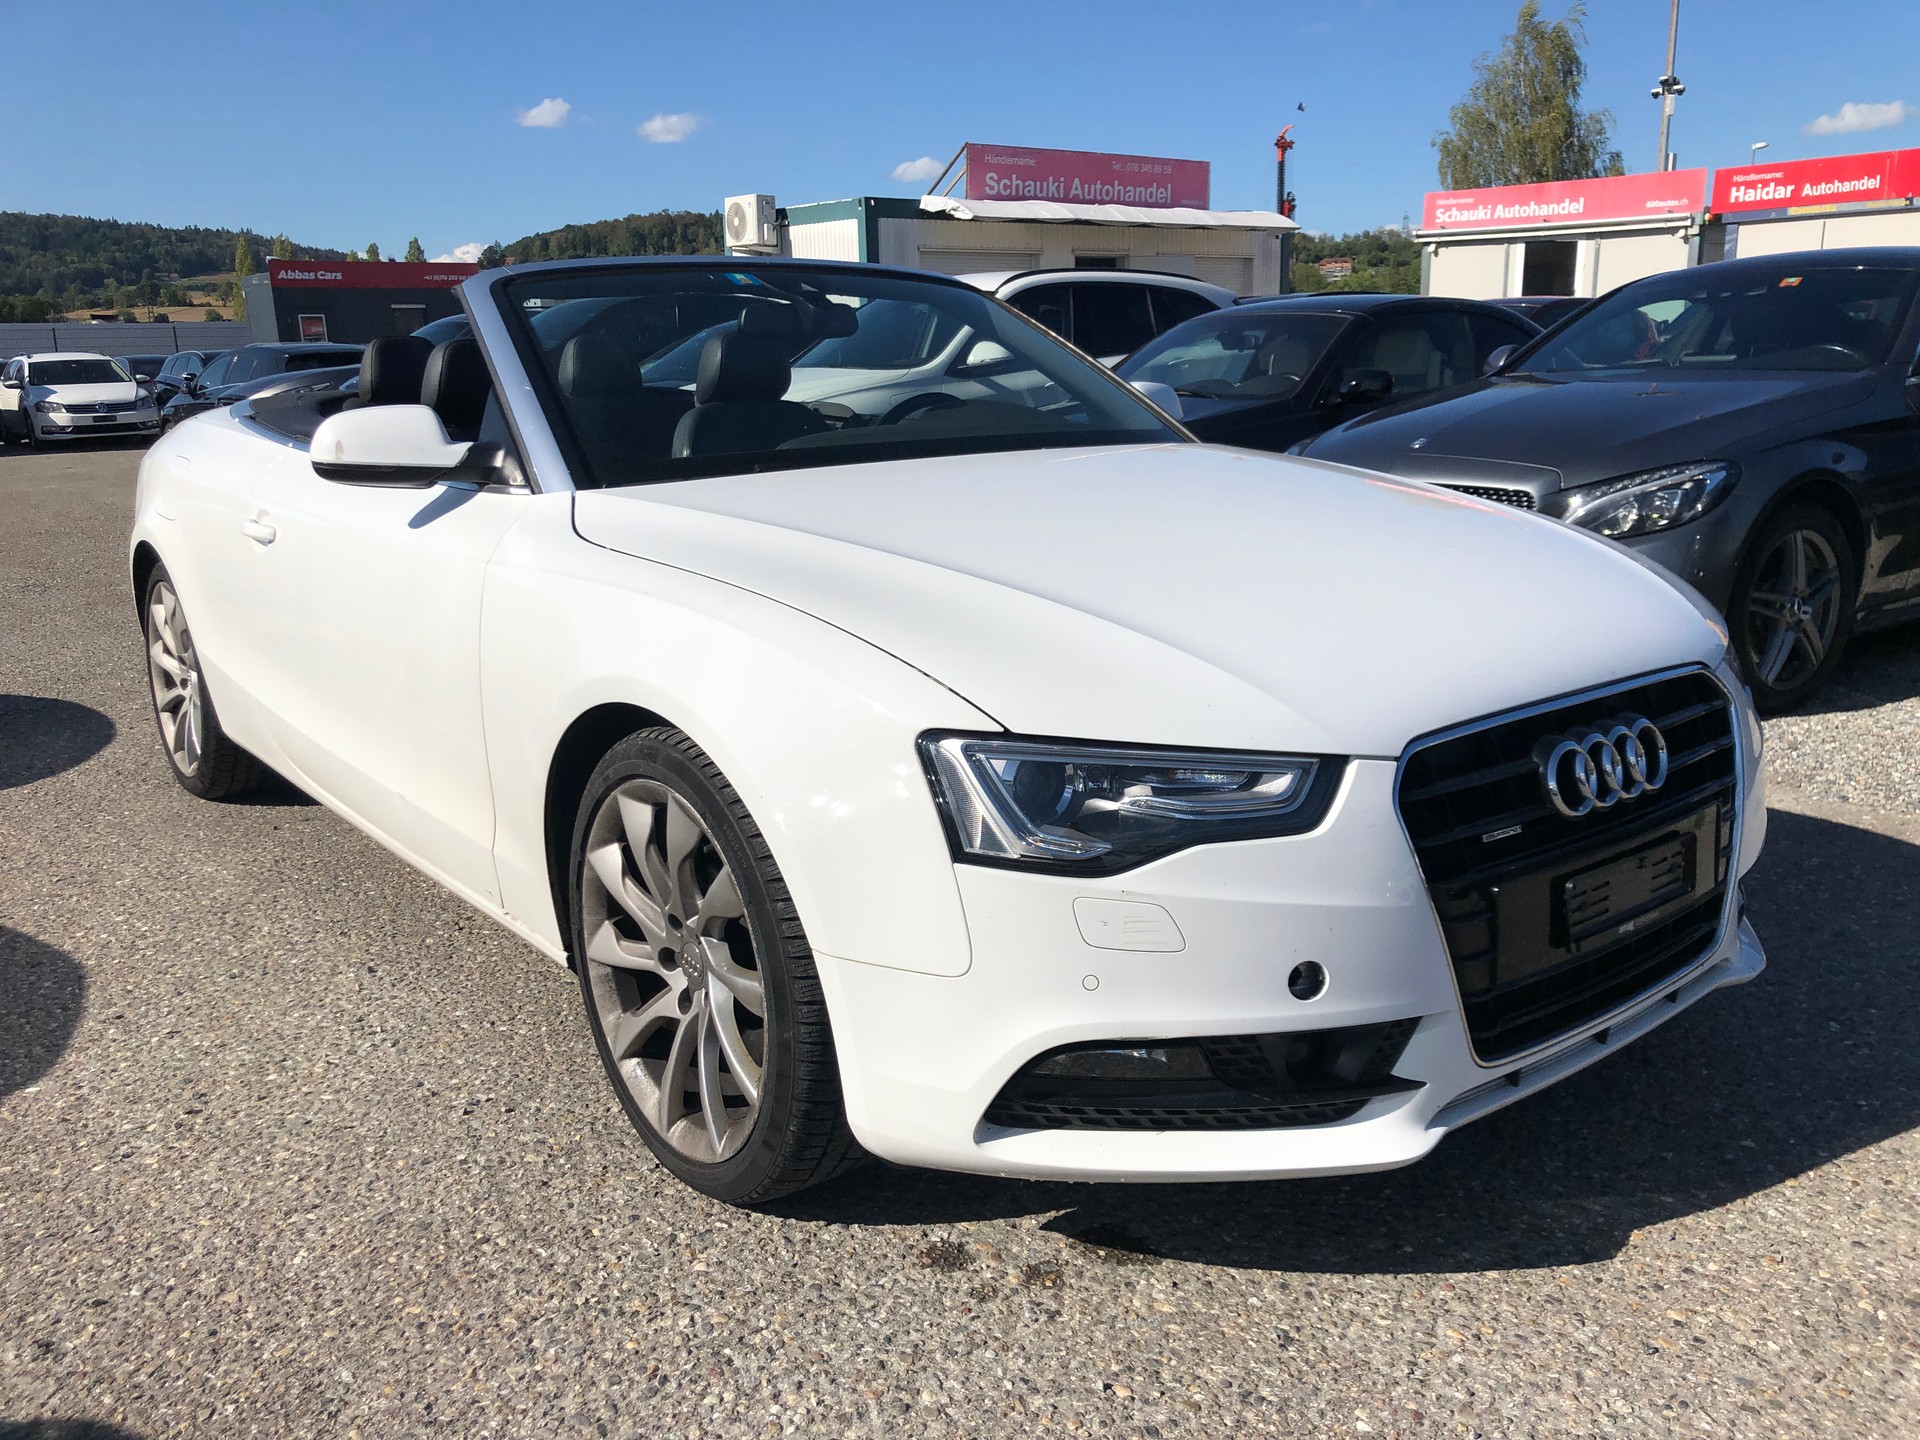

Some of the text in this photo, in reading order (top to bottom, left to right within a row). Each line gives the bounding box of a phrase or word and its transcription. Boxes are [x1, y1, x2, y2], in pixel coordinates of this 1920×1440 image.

[985, 172, 1172, 204] Schauki Autohandel
[1729, 174, 1881, 204] Haidar Autohandel
[1435, 197, 1585, 223] Schauki Autohandel
[278, 270, 343, 280] Abbas Cars
